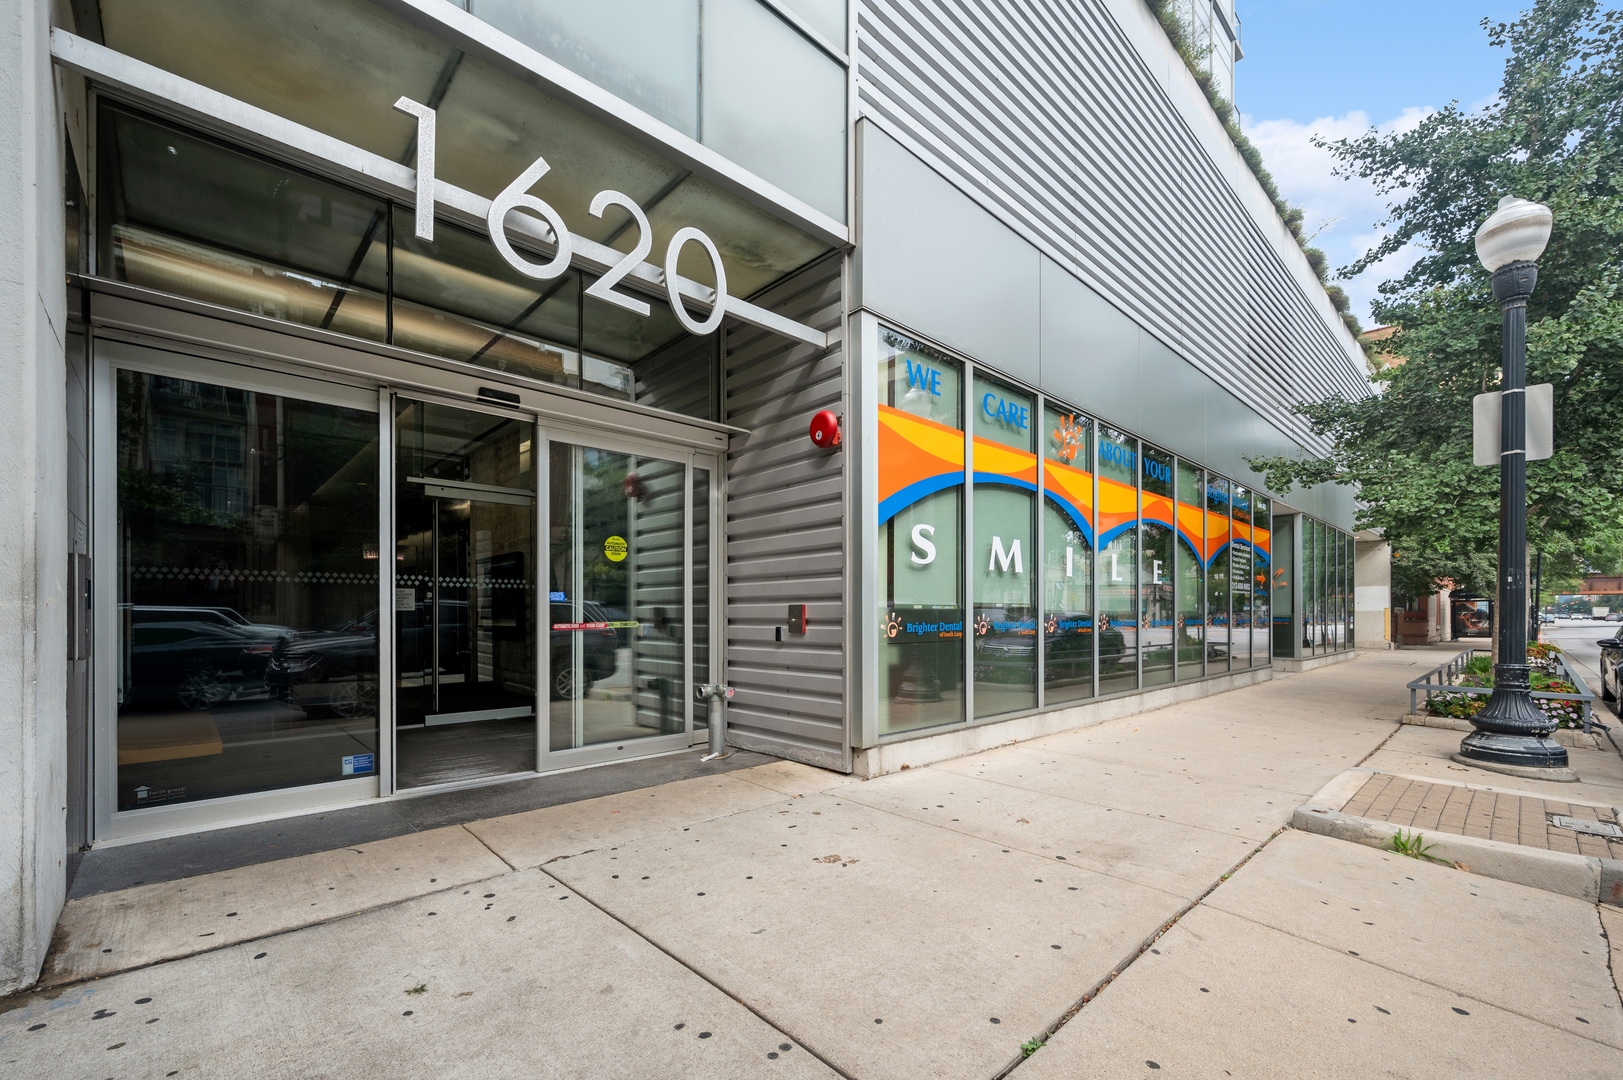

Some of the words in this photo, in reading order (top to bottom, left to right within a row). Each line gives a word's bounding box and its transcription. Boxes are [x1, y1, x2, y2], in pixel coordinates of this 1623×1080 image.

[393, 95, 728, 336] 1620
[906, 359, 942, 397] WE
[983, 393, 1029, 430] CARE
[1098, 440, 1137, 471] ABOUT
[1144, 457, 1171, 484] YOUR
[906, 622, 938, 635] Brighter
[939, 621, 963, 632] Dental
[1059, 620, 1077, 630] Brighter
[1078, 619, 1092, 628] Dental
